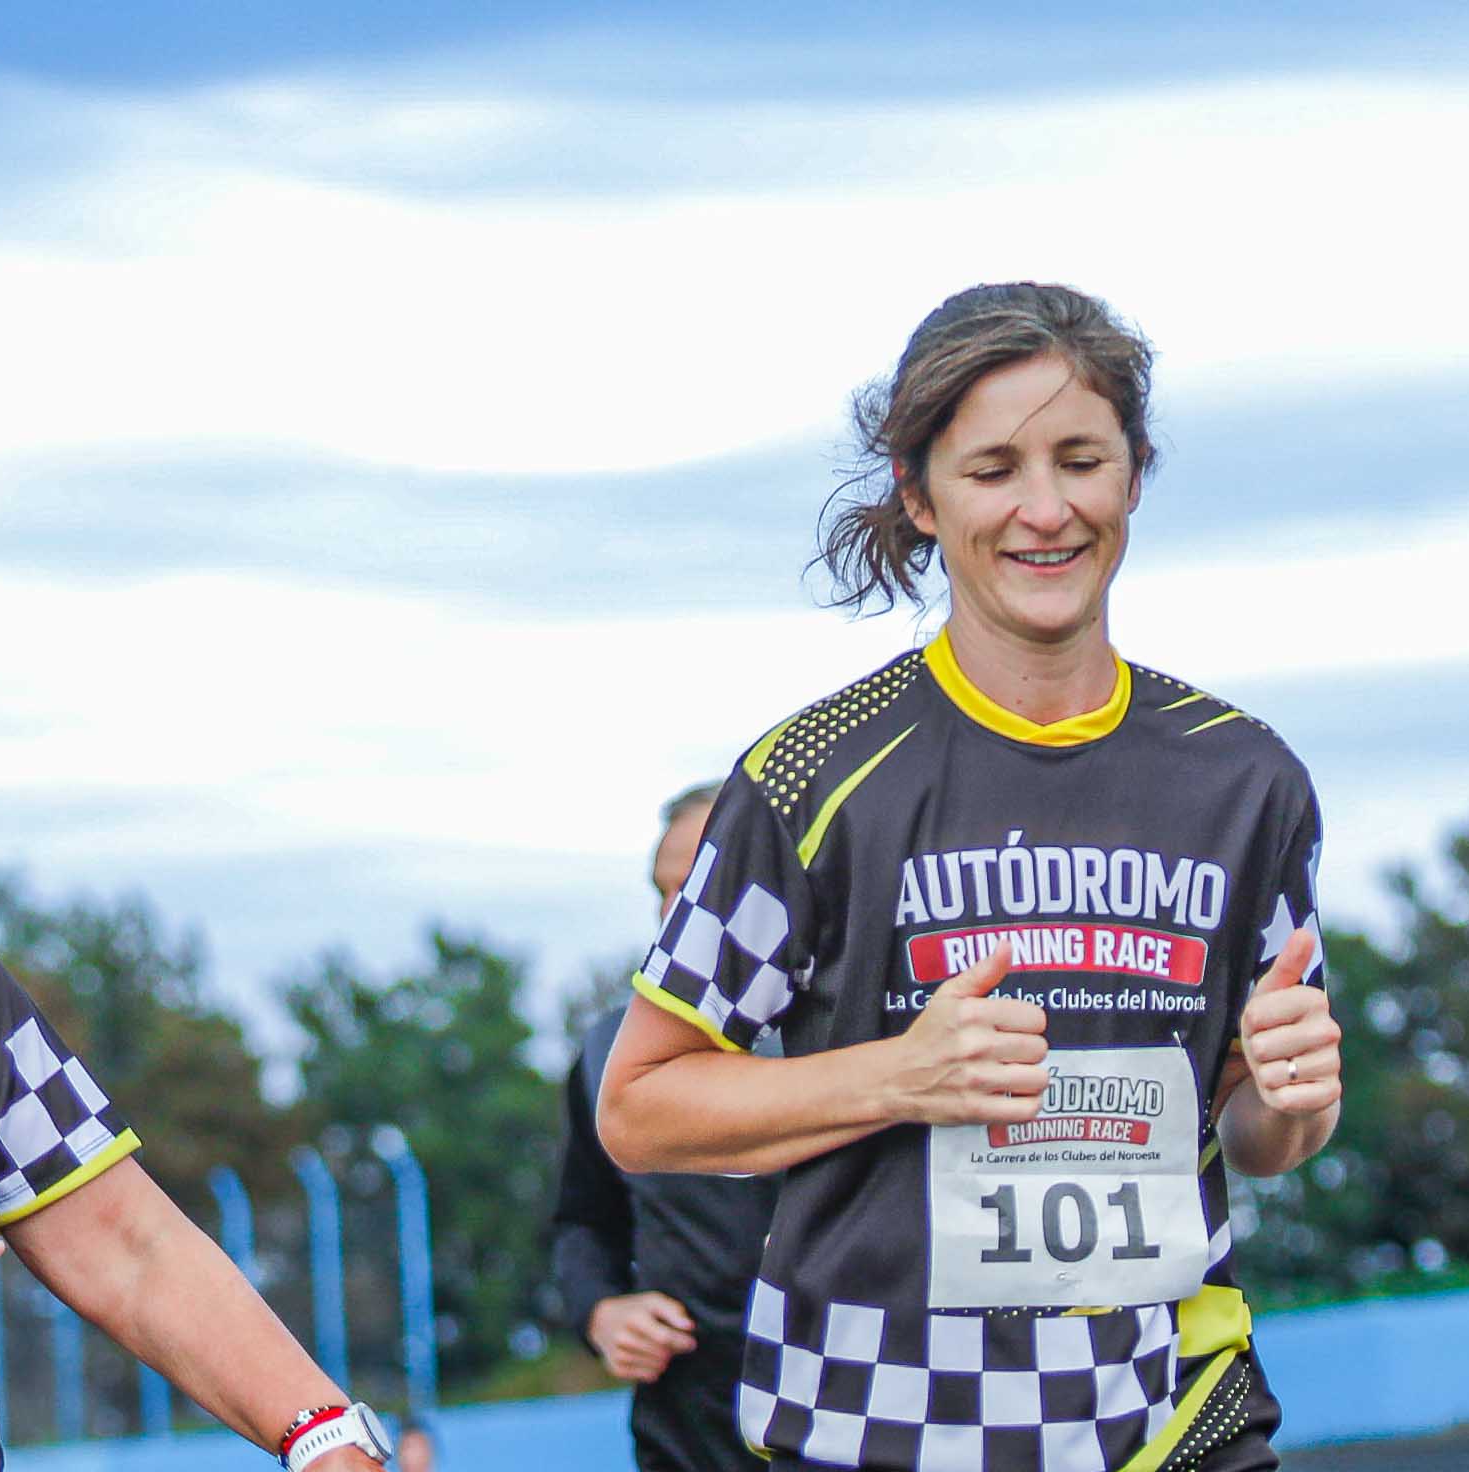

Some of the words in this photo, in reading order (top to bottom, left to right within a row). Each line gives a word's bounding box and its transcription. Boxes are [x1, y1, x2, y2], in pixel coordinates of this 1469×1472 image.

[894, 829, 1227, 930] AUTÓDROMO
[1094, 930, 1172, 976] RACE
[886, 991, 906, 1010] La
[1049, 988, 1113, 1010] Clubes
[1117, 988, 1146, 1010] del
[1043, 1066, 1164, 1116] ÓDROMO
[1007, 1119, 1085, 1145] RUNNING
[1089, 1118, 1133, 1142] RACE
[970, 1152, 984, 1163] La
[986, 1152, 1026, 1163] Carrera
[1028, 1151, 1041, 1162] de
[1044, 1151, 1058, 1161] los
[1061, 1150, 1097, 1161] Clubes
[1099, 1150, 1116, 1160] del
[1118, 1150, 1161, 1161] Noroeste
[981, 1181, 1161, 1263] 101
